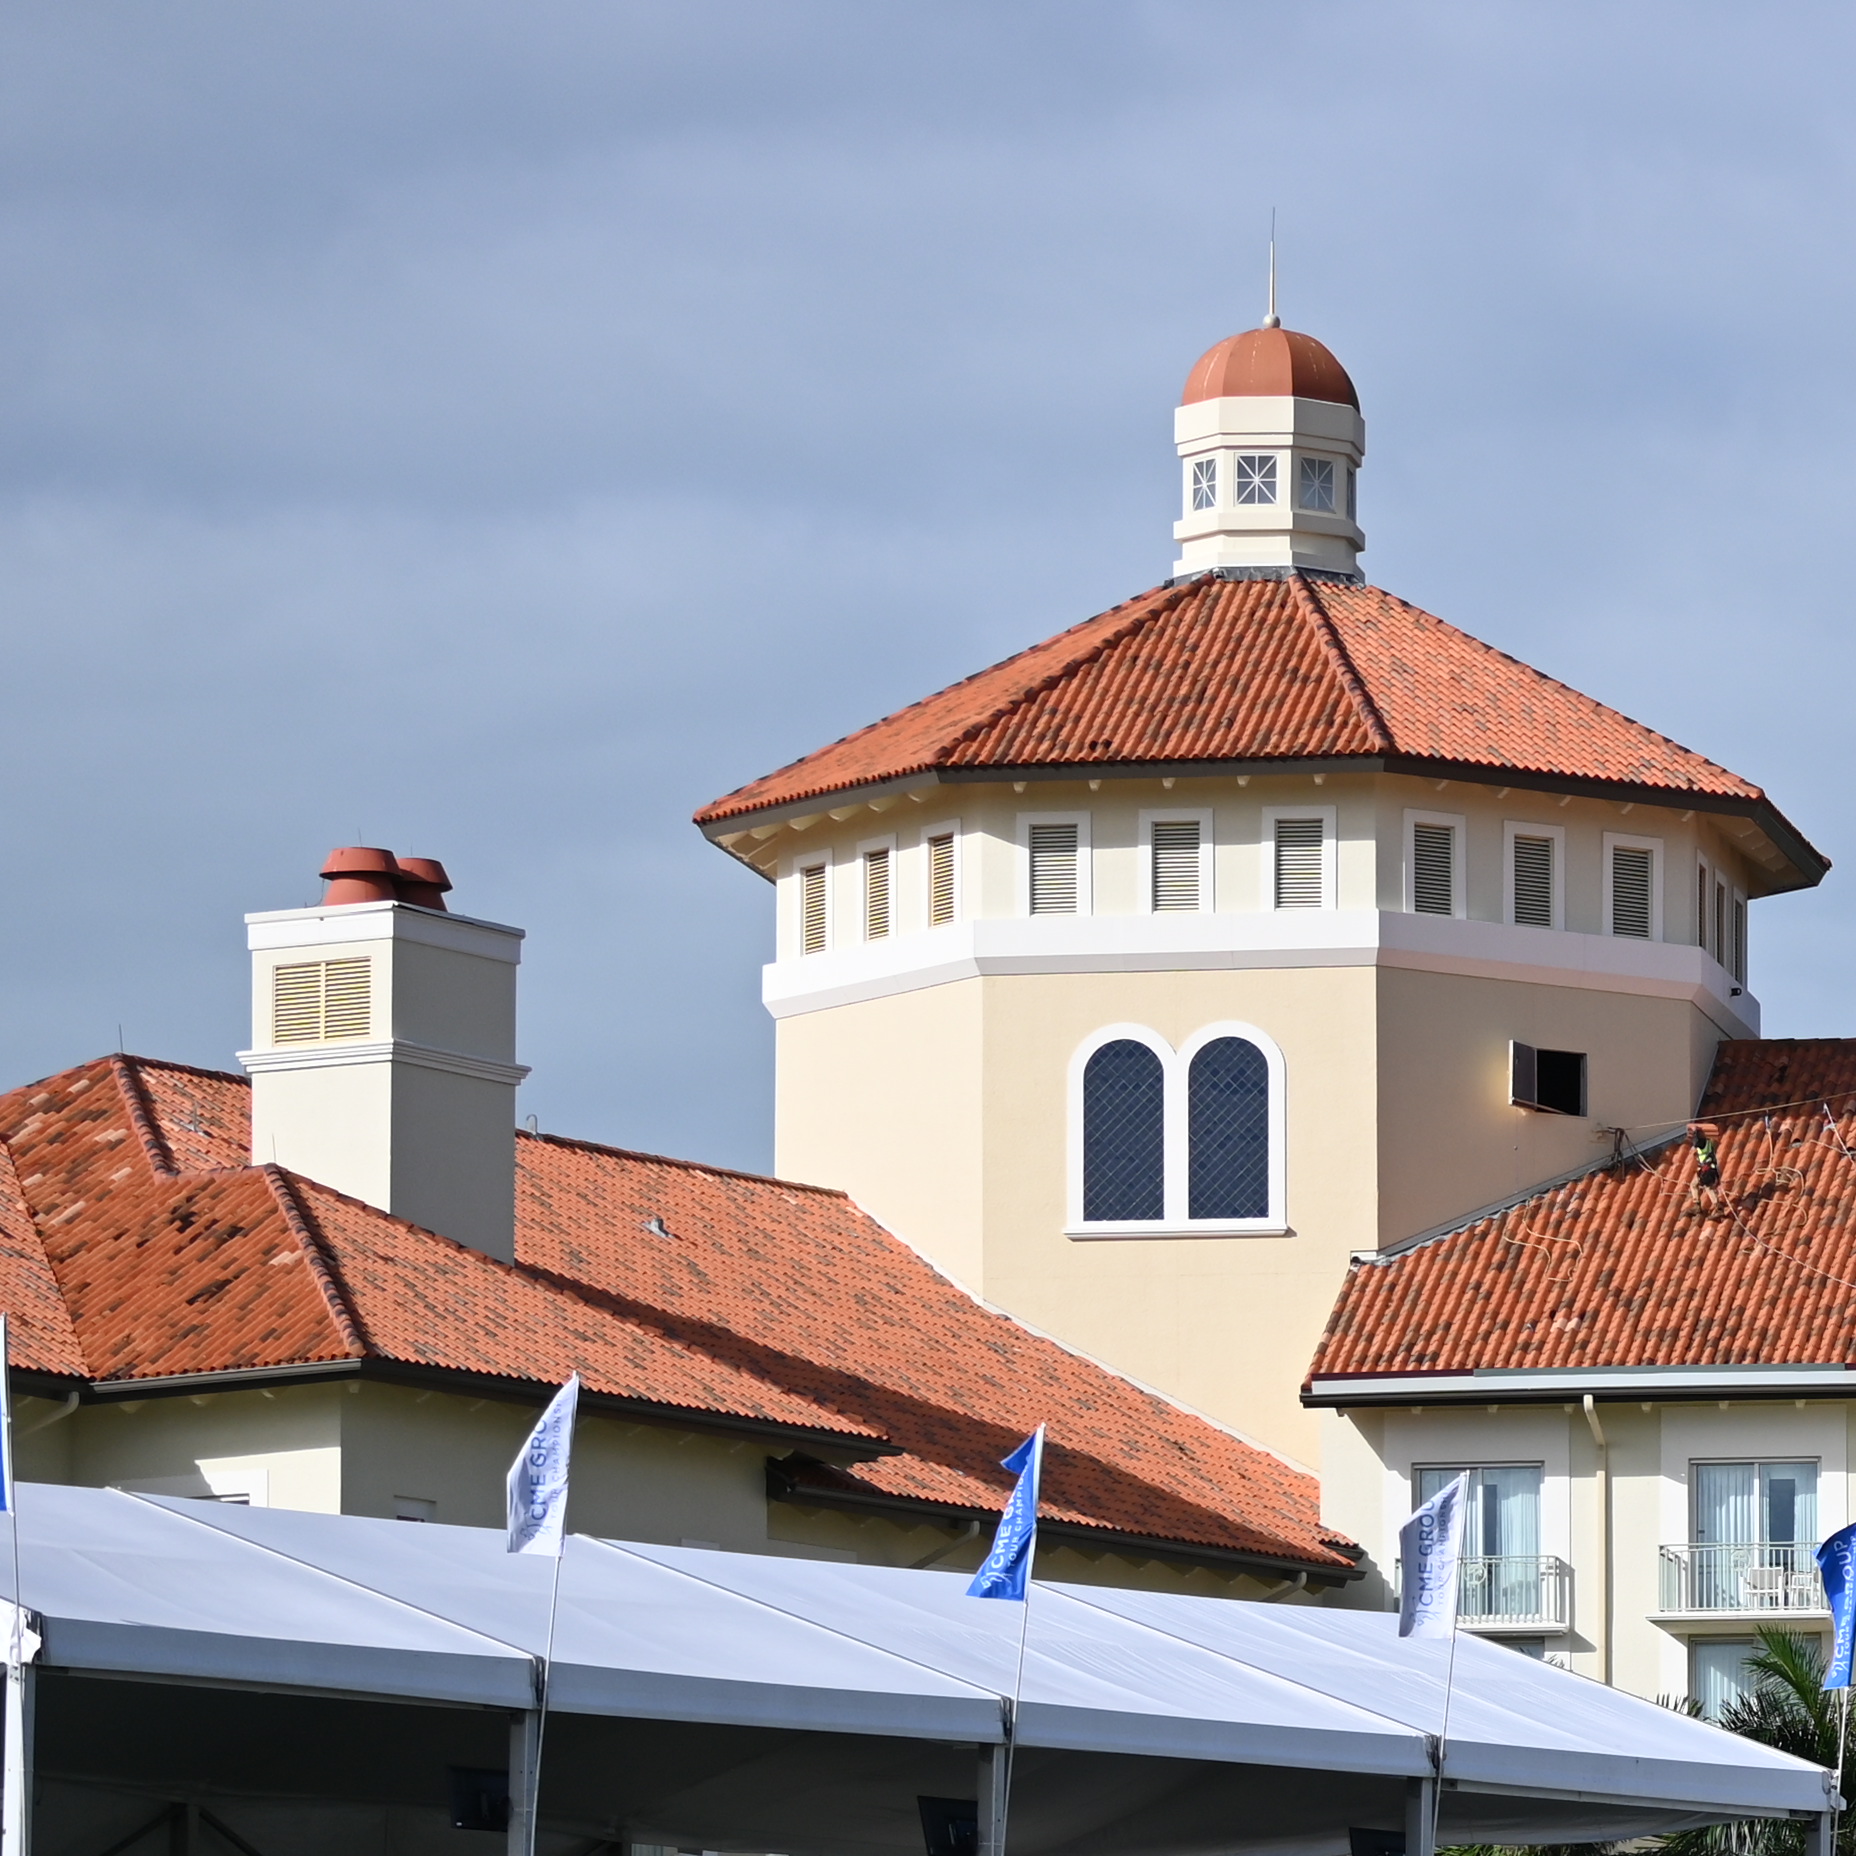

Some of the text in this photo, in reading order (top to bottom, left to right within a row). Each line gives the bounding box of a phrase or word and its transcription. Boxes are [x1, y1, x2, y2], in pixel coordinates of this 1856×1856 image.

[530, 1473, 547, 1521] CME
[991, 1525, 1012, 1569] CME
[1007, 1535, 1020, 1567] TOUR
[1418, 1500, 1436, 1606] CME GROU
